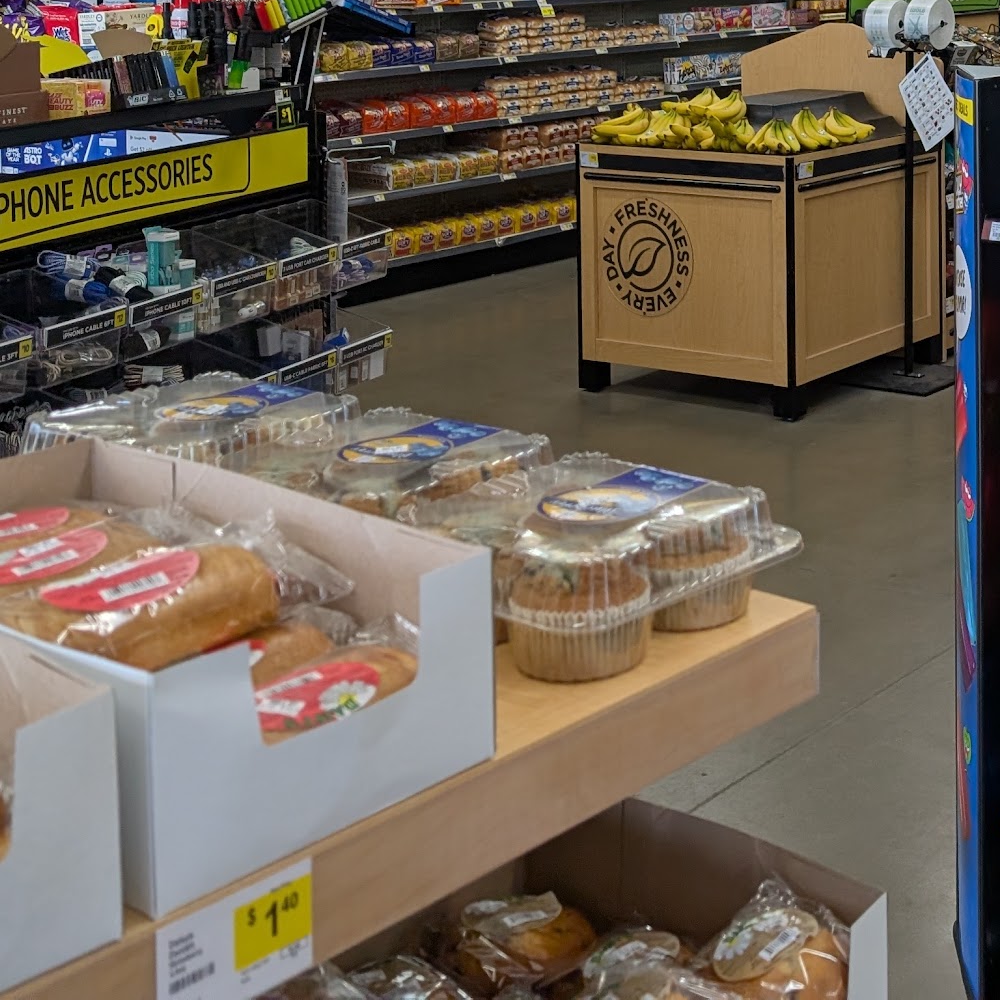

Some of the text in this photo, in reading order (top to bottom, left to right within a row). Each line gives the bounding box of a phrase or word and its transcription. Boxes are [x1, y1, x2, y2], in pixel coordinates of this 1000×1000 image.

[281, 105, 293, 124] $1
[24, 146, 42, 154] ASTRO
[81, 154, 214, 208] ACCESSORIES
[614, 200, 690, 277] FRESHNESS
[602, 240, 619, 282] DAY
[164, 301, 180, 311] CABLE
[621, 287, 678, 313] EVERY
[85, 323, 103, 334] CABLE
